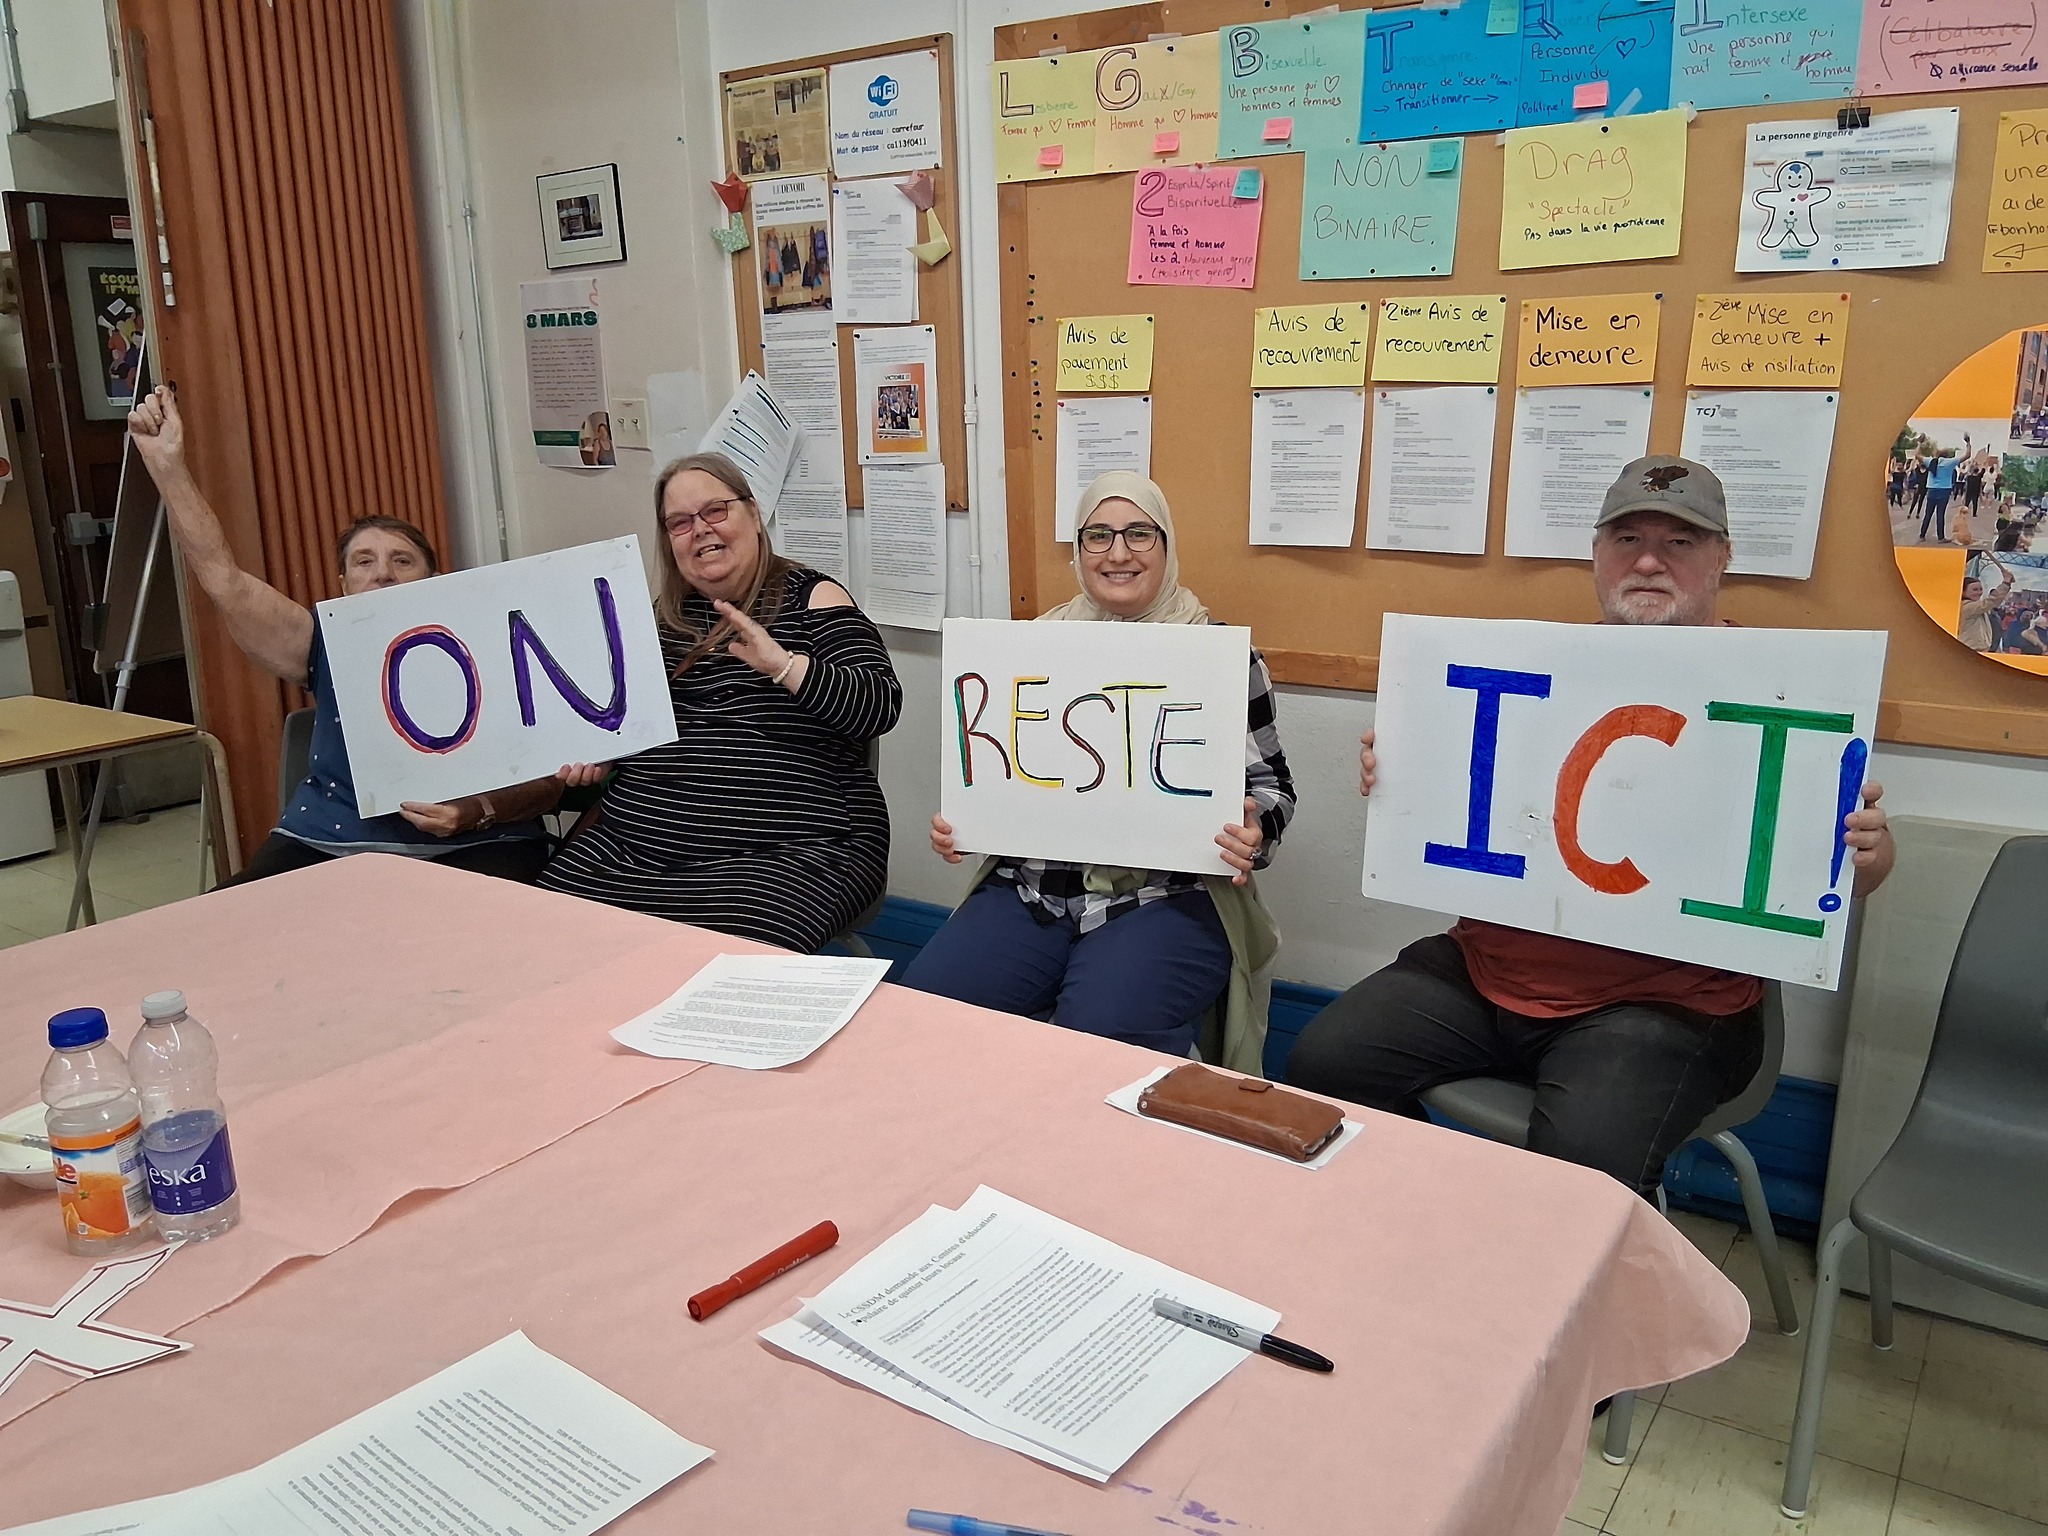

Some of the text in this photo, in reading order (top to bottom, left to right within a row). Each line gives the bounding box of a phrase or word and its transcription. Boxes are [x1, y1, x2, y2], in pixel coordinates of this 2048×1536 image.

[1531, 42, 1597, 60] Personne
[1688, 24, 1835, 58] Une personne qui
[1728, 56, 1772, 69] femme
[1806, 65, 1852, 79] homme
[1539, 65, 1609, 83] Individu
[1228, 80, 1318, 101] Une personne qui
[1382, 79, 1428, 99] Changer
[1440, 77, 1453, 87] de
[868, 108, 899, 119] GRATUIT
[1241, 102, 1282, 112] hommes
[1303, 97, 1341, 107] femmes
[835, 131, 849, 139] Nom
[852, 130, 859, 138] du
[862, 128, 884, 137] réseau
[892, 122, 925, 134] carrefour
[1001, 124, 1028, 135] Femme
[1110, 115, 1145, 131] Homme
[1190, 109, 1218, 121] homme
[1755, 134, 1766, 142] La
[1768, 132, 1811, 143] personne
[1812, 129, 1854, 140] gingenre
[861, 144, 879, 154] passe
[1333, 152, 1423, 189] NON
[1136, 171, 1167, 217] 2
[1160, 225, 1168, 236] la
[1172, 224, 1189, 237] fois
[1548, 226, 1573, 238] dans
[1581, 222, 1591, 233] la
[1594, 221, 1608, 232] vie
[1149, 238, 1226, 249] femme et homme
[540, 311, 598, 328] MARS
[1268, 307, 1347, 332] Avis de
[1428, 301, 1462, 321] Avis
[1471, 303, 1490, 322] de
[1536, 305, 1641, 334] Mise en
[1747, 302, 1790, 325] Mise
[1807, 309, 1834, 324] en
[1066, 322, 1130, 345] Avis de
[1385, 332, 1495, 353] recouvrement
[1711, 328, 1805, 346] demeure
[1258, 339, 1362, 366] recouvrement
[1529, 344, 1644, 368] demeure
[1061, 352, 1129, 376] paiement
[1700, 355, 1731, 372] Avis
[1741, 357, 1755, 373] de
[1696, 406, 1717, 418] TCJ
[382, 576, 630, 756] ON
[954, 671, 1214, 798] RESTE
[1423, 662, 1869, 939] ICI!
[838, 1211, 998, 1319] Le CSSDM demande aux Centres d'éducation
[887, 1297, 899, 1307] de
[921, 1268, 943, 1283] leurs
[941, 1251, 967, 1270] locaux
